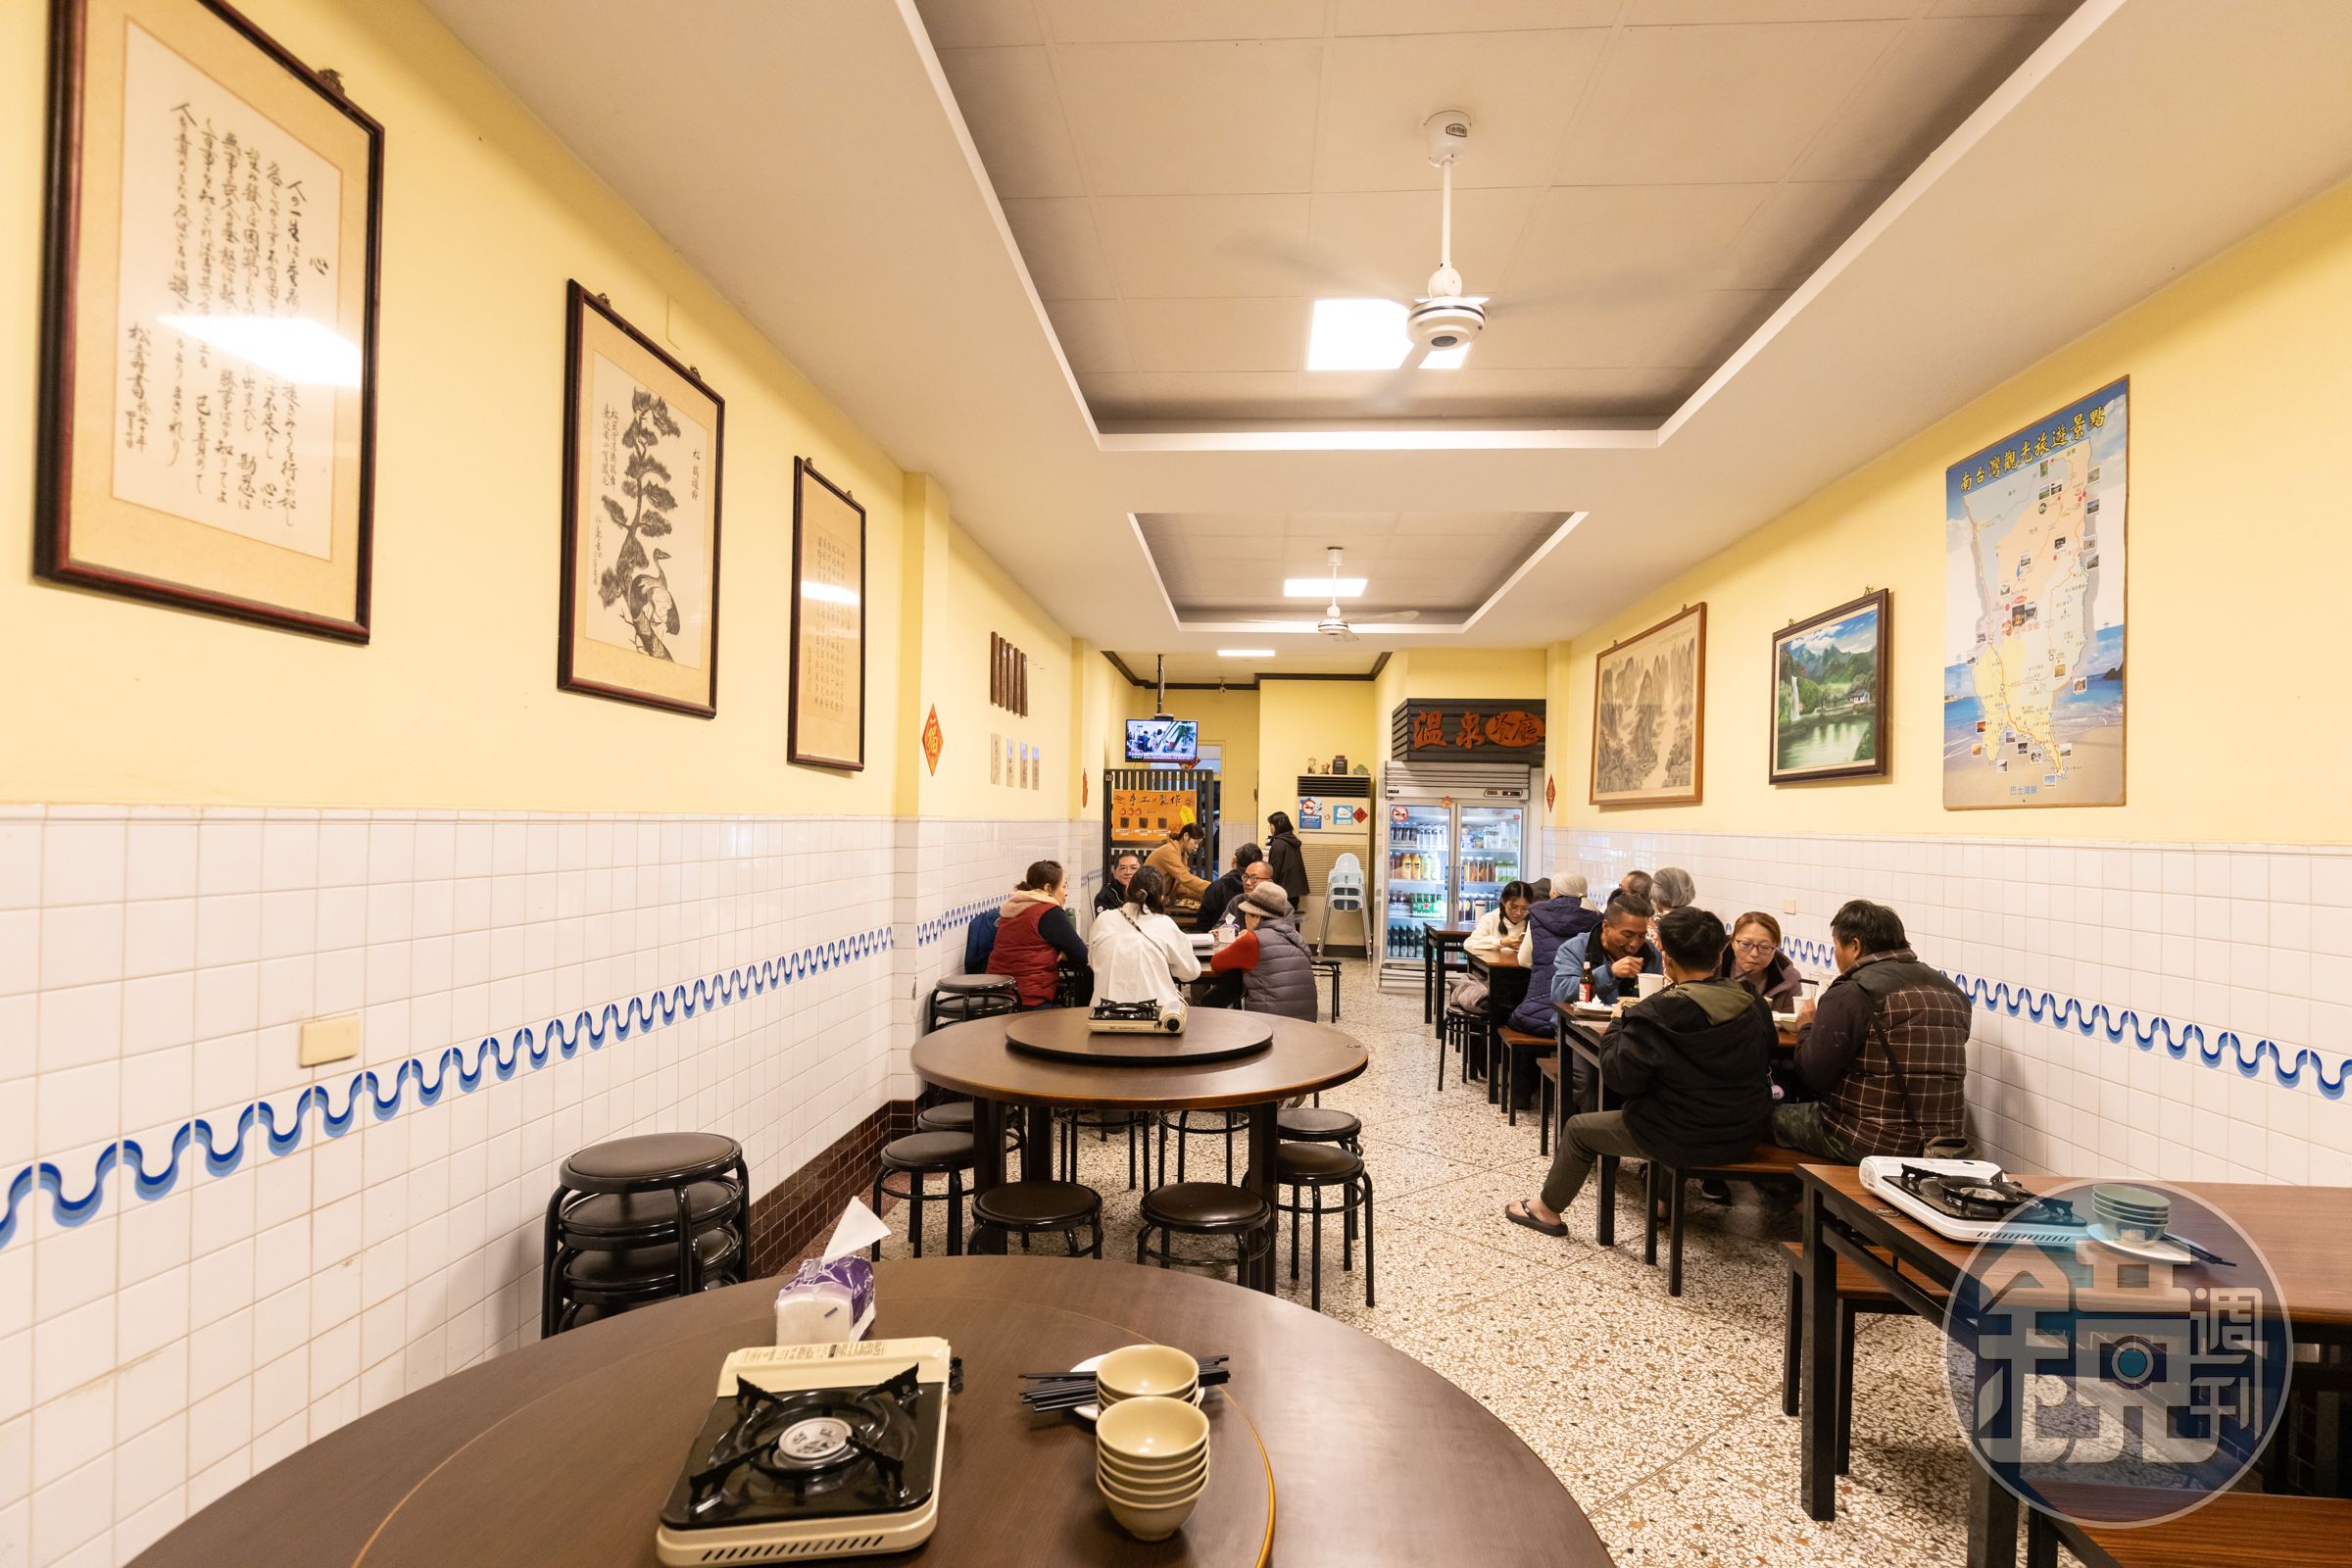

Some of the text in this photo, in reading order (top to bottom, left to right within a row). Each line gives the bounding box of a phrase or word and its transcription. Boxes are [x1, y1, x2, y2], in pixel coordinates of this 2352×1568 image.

[1960, 406, 2106, 491] 南台灣觀光旅遊景點
[926, 717, 939, 755] 福
